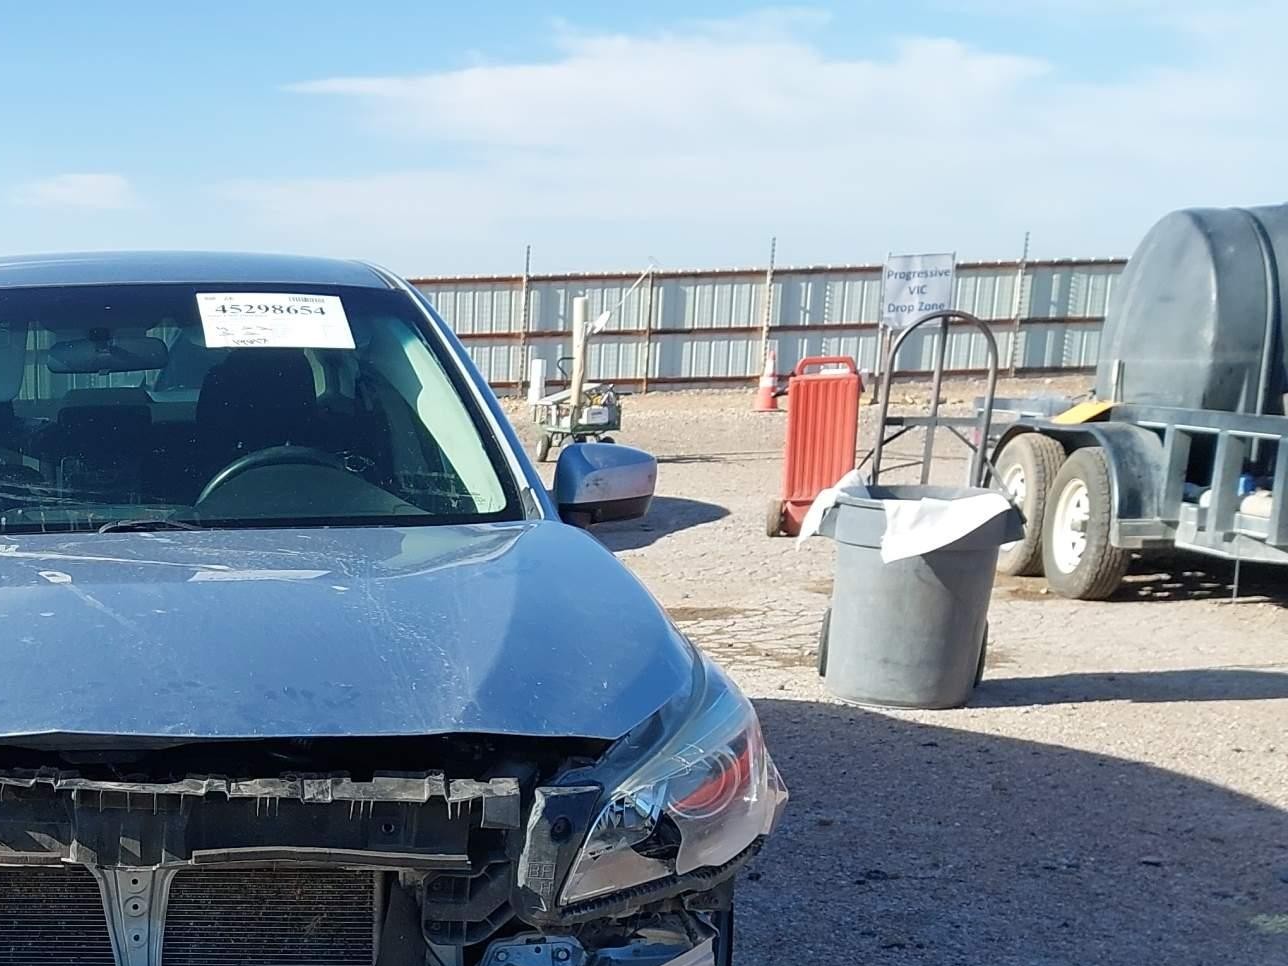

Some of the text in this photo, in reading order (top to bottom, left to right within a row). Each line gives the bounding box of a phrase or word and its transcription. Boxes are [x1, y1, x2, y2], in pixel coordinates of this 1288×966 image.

[887, 268, 951, 280] Progressive
[908, 284, 928, 295] VIC
[215, 304, 326, 316] 45298654
[887, 301, 946, 313] Drop Zone
